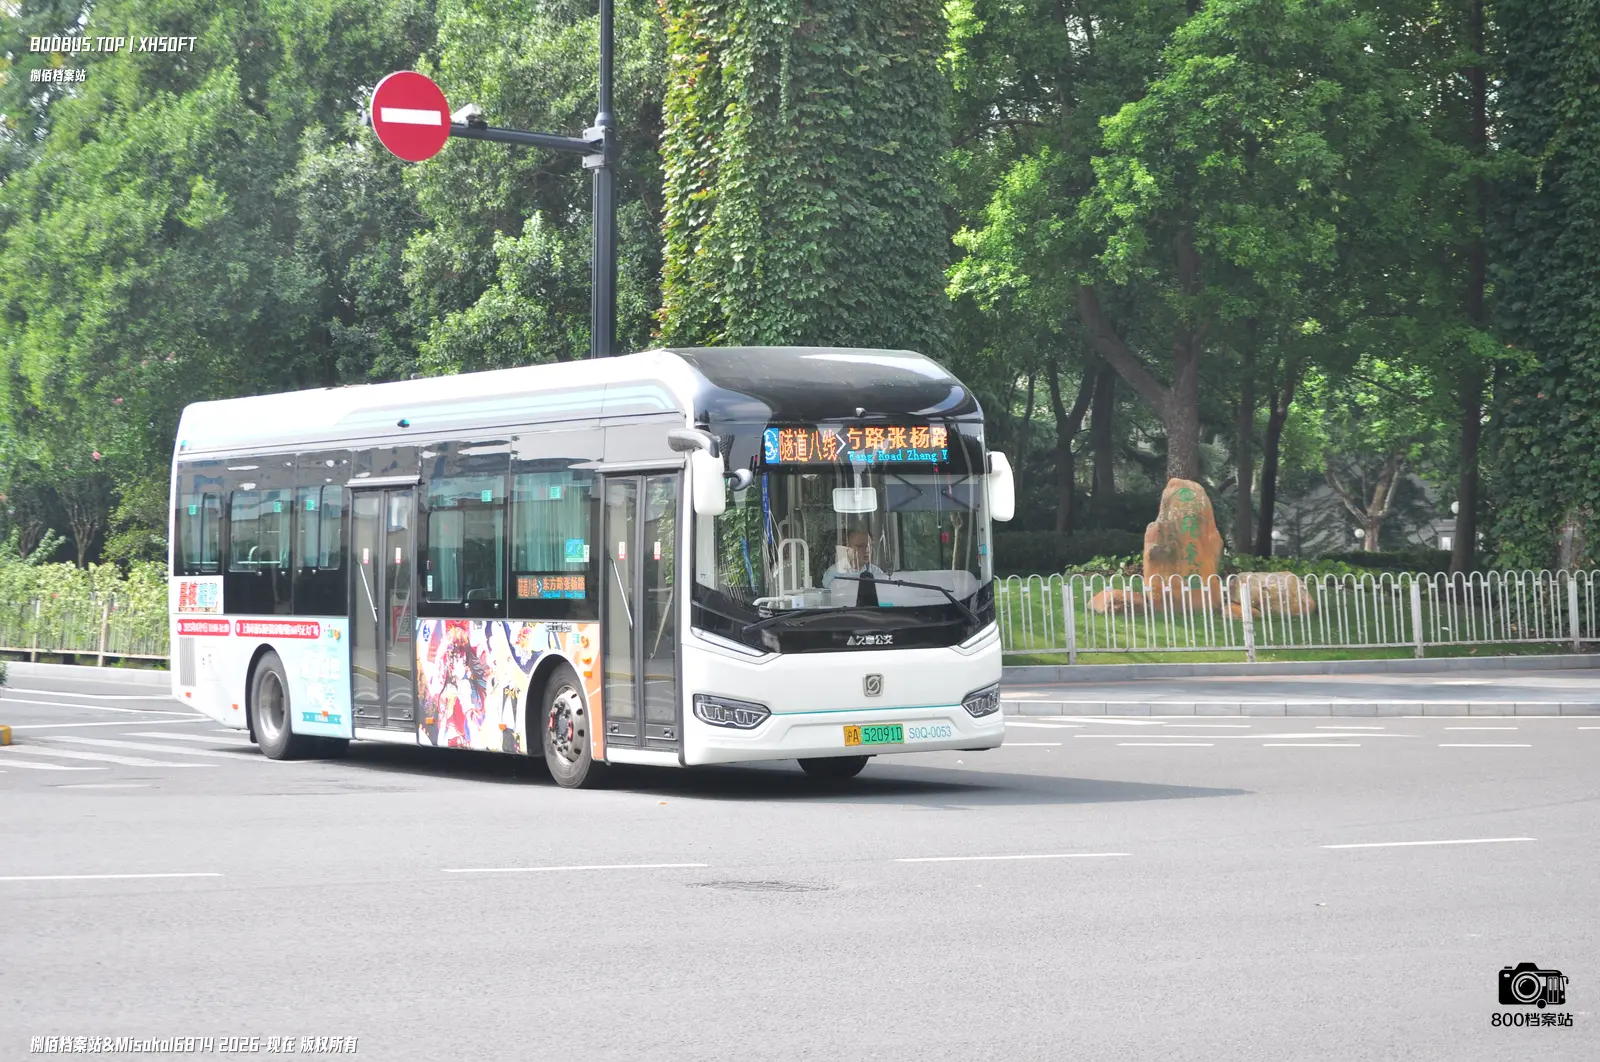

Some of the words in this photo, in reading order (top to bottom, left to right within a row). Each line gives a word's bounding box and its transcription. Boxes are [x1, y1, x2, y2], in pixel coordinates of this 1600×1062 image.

[778, 428, 838, 462] 隧道八线
[878, 450, 902, 461] Road
[906, 449, 937, 463] Zhang
